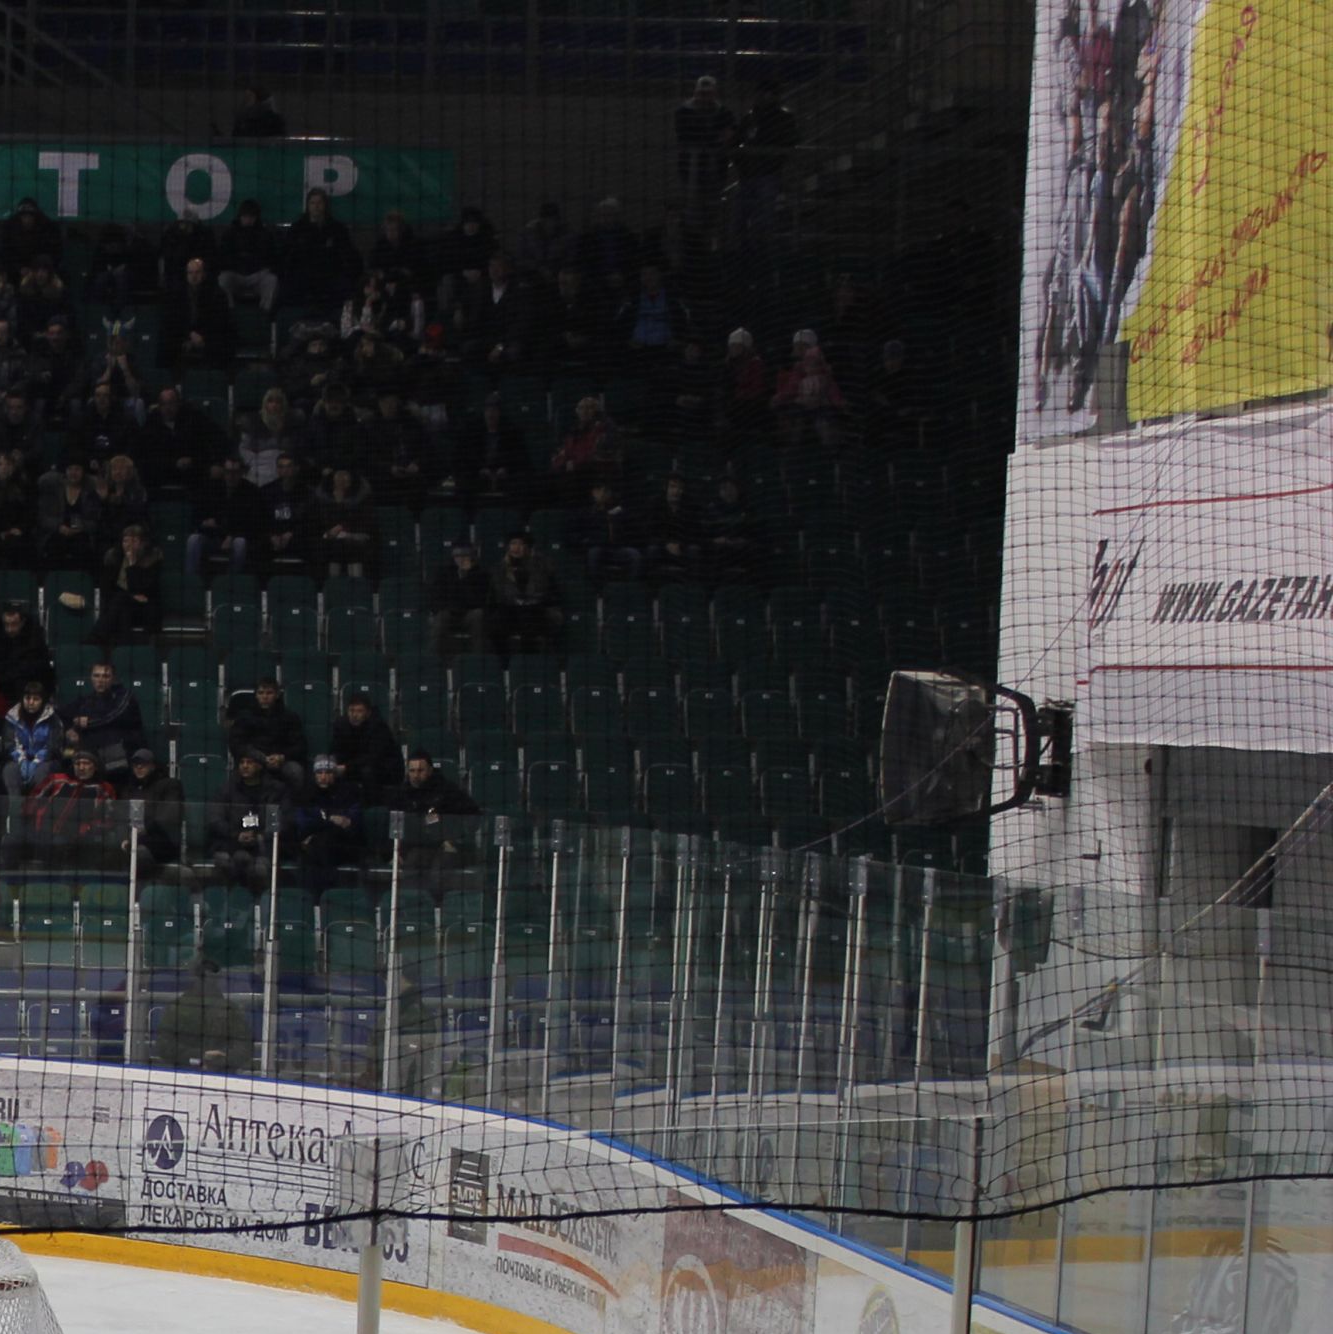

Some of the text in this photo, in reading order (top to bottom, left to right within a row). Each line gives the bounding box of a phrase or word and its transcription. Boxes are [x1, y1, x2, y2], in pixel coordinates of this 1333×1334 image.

[1151, 574, 1333, 624] WWW.GAZETAH
[201, 1104, 328, 1164] Аптека
[141, 1178, 228, 1207] ДОСТАВКА
